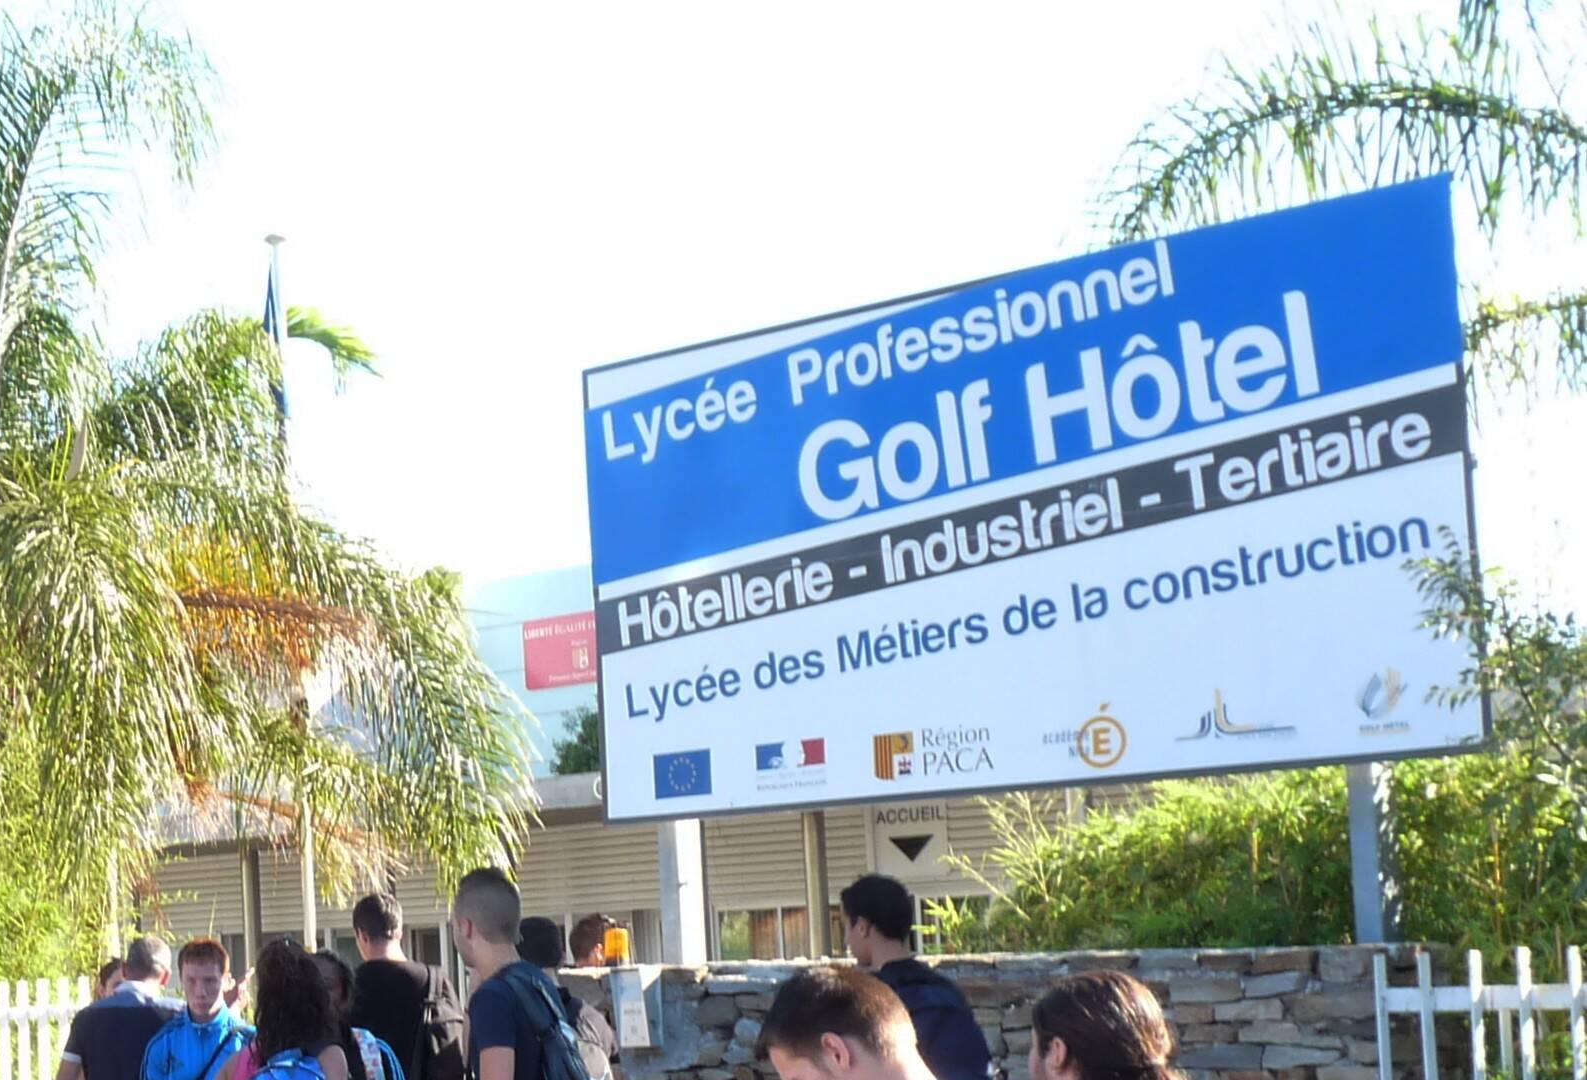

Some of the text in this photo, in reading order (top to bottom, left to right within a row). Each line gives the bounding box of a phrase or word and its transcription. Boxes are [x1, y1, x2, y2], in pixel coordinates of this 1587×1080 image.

[602, 239, 1175, 464] Lycée Professionnel
[797, 290, 1320, 520] Golf Hôtel
[617, 557, 834, 647] Hôtellerie
[880, 477, 1124, 584] Industriel
[1174, 411, 1432, 510] Tertiaire
[625, 516, 1431, 722] Lycée des Métiers de la construction
[875, 805, 945, 825] ACCUEIL
[921, 725, 991, 749] Région
[922, 747, 995, 776] PACA
